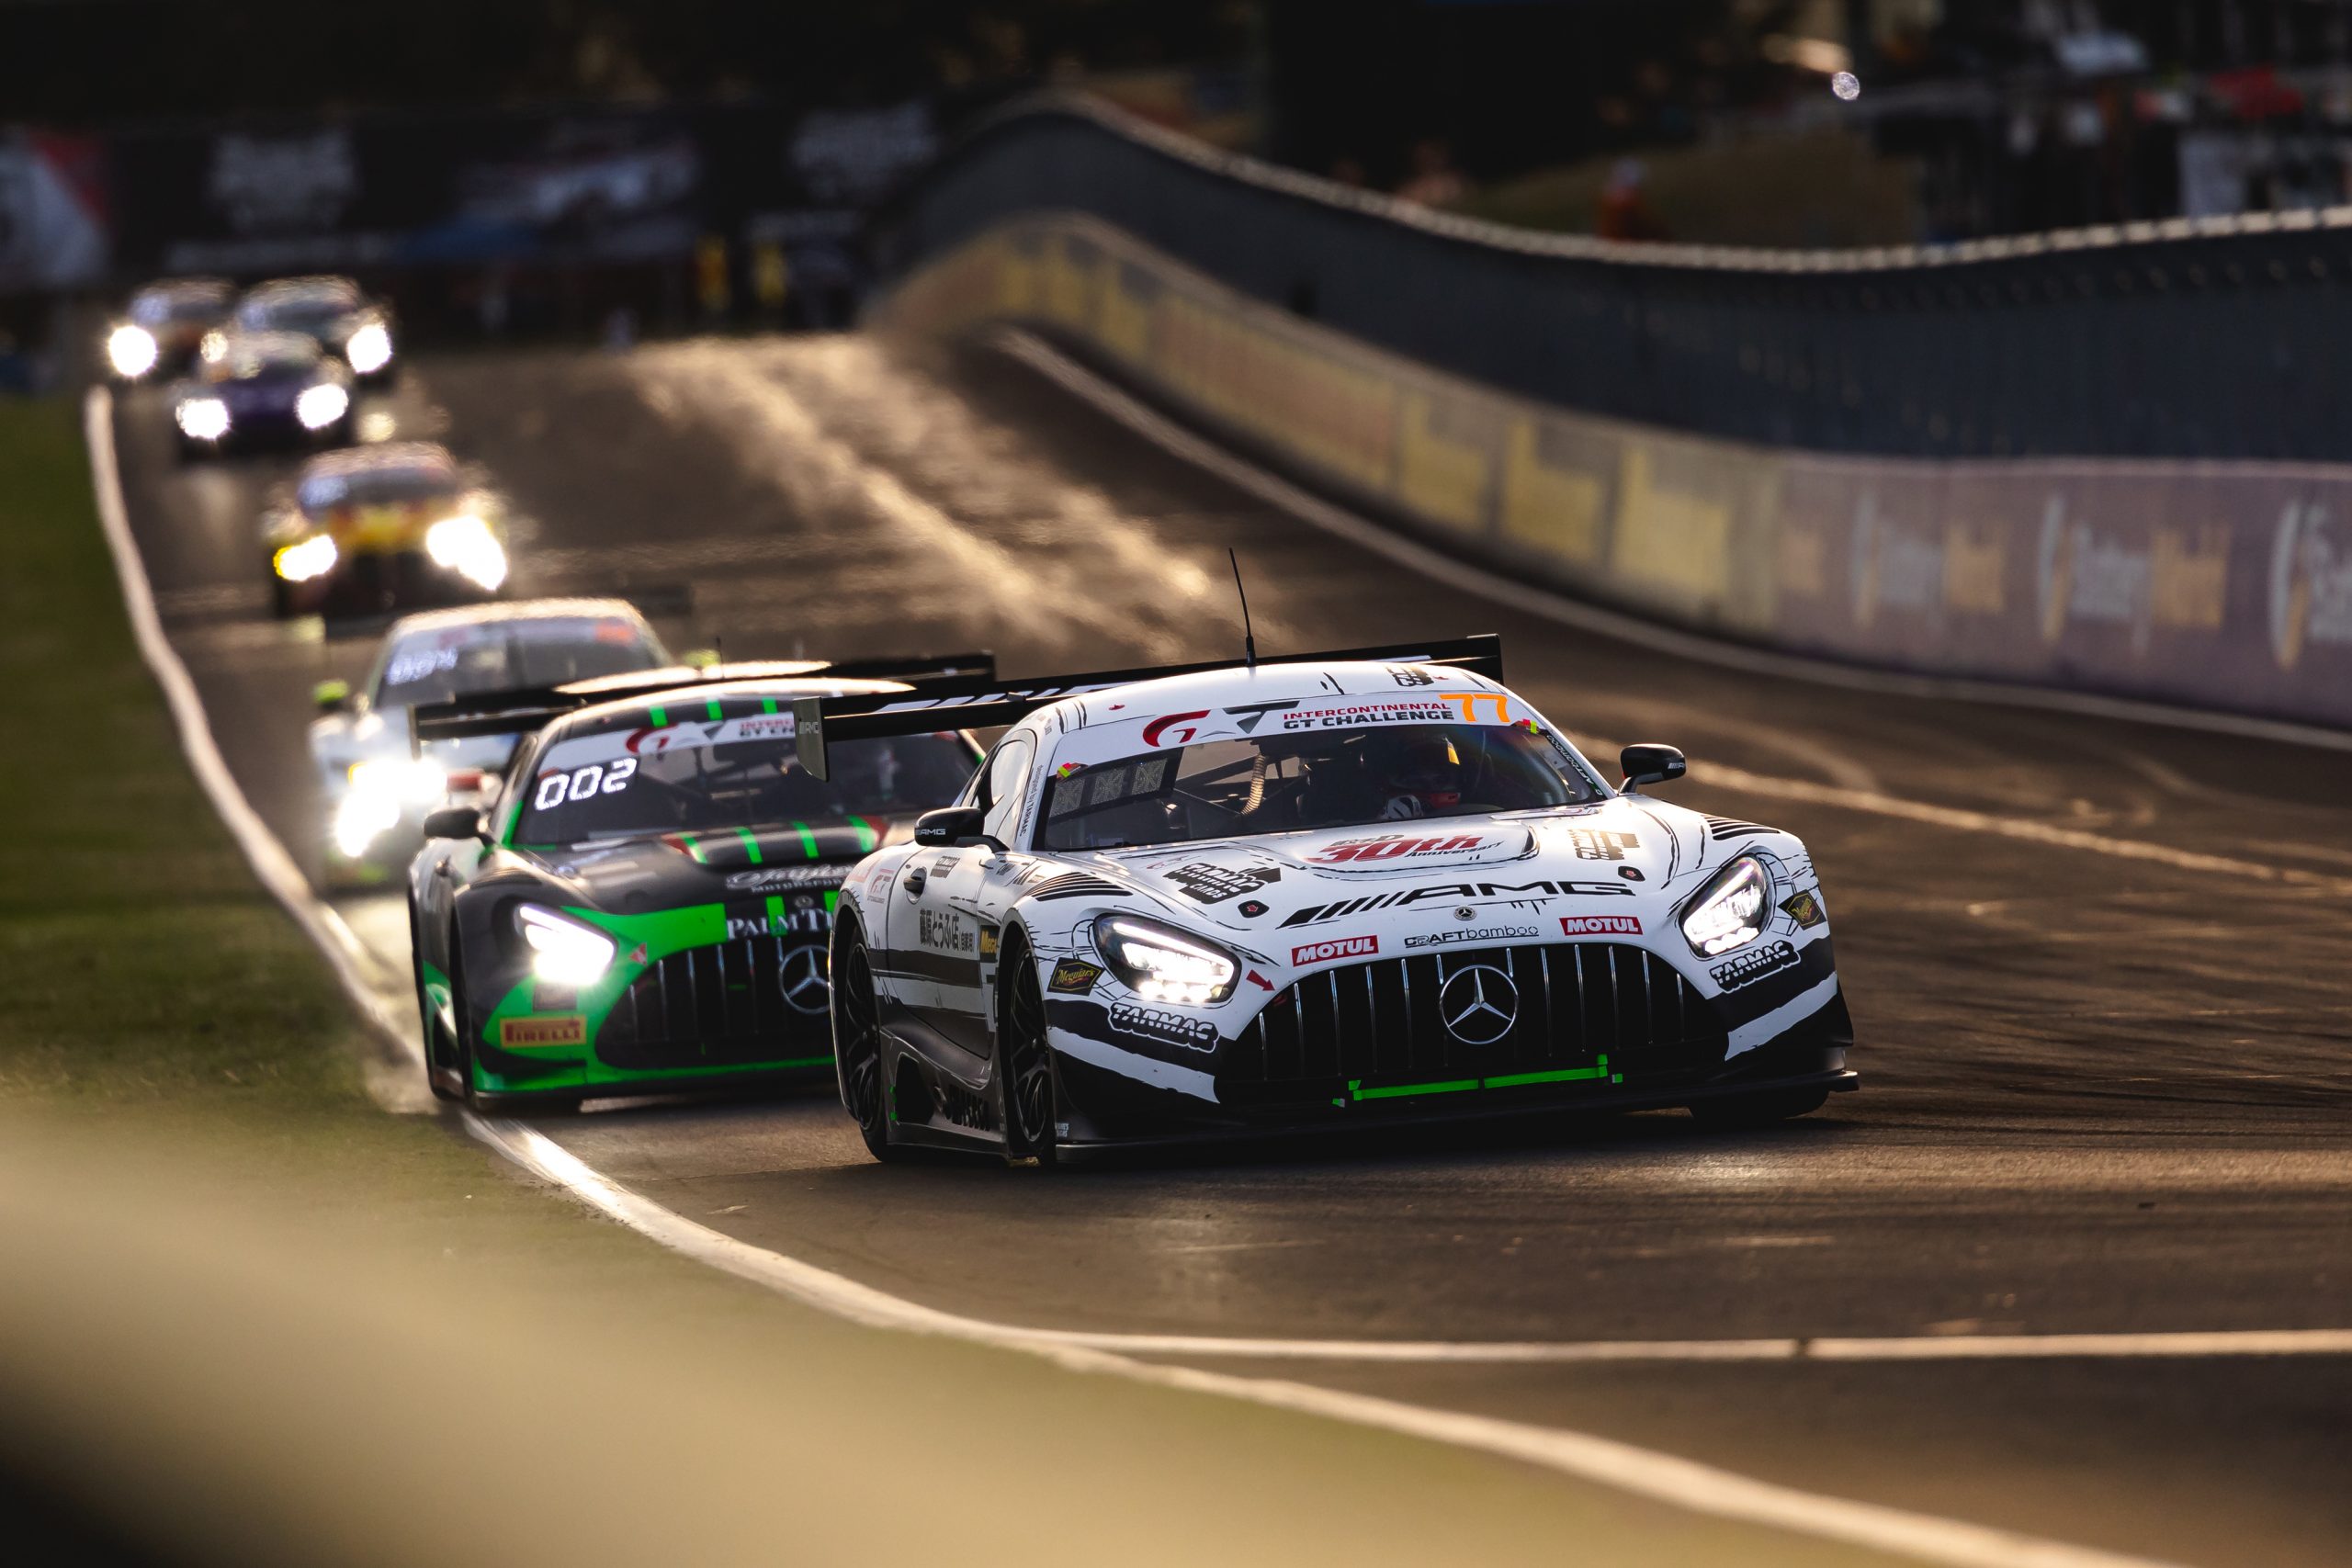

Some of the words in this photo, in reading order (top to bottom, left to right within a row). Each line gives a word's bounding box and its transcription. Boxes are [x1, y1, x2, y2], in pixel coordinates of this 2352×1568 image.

[1283, 702, 1452, 720] INTERCONTINENTAL
[1283, 718, 1316, 730] GT
[1321, 710, 1454, 728] CHALLENGE
[1439, 694, 1510, 723] 77
[1546, 734, 1603, 795] CAFTbamboo
[534, 757, 638, 811] 002
[1306, 834, 1483, 864] 30th
[1404, 840, 1505, 858] Anniversary
[1396, 879, 1636, 907] AMG
[1566, 918, 1638, 932] MOTUL
[1296, 937, 1374, 964] MOTUL
[1711, 941, 1790, 984] TARMAC
[504, 1019, 581, 1043] PIRELLI
[1113, 1003, 1214, 1040] TARMAC
